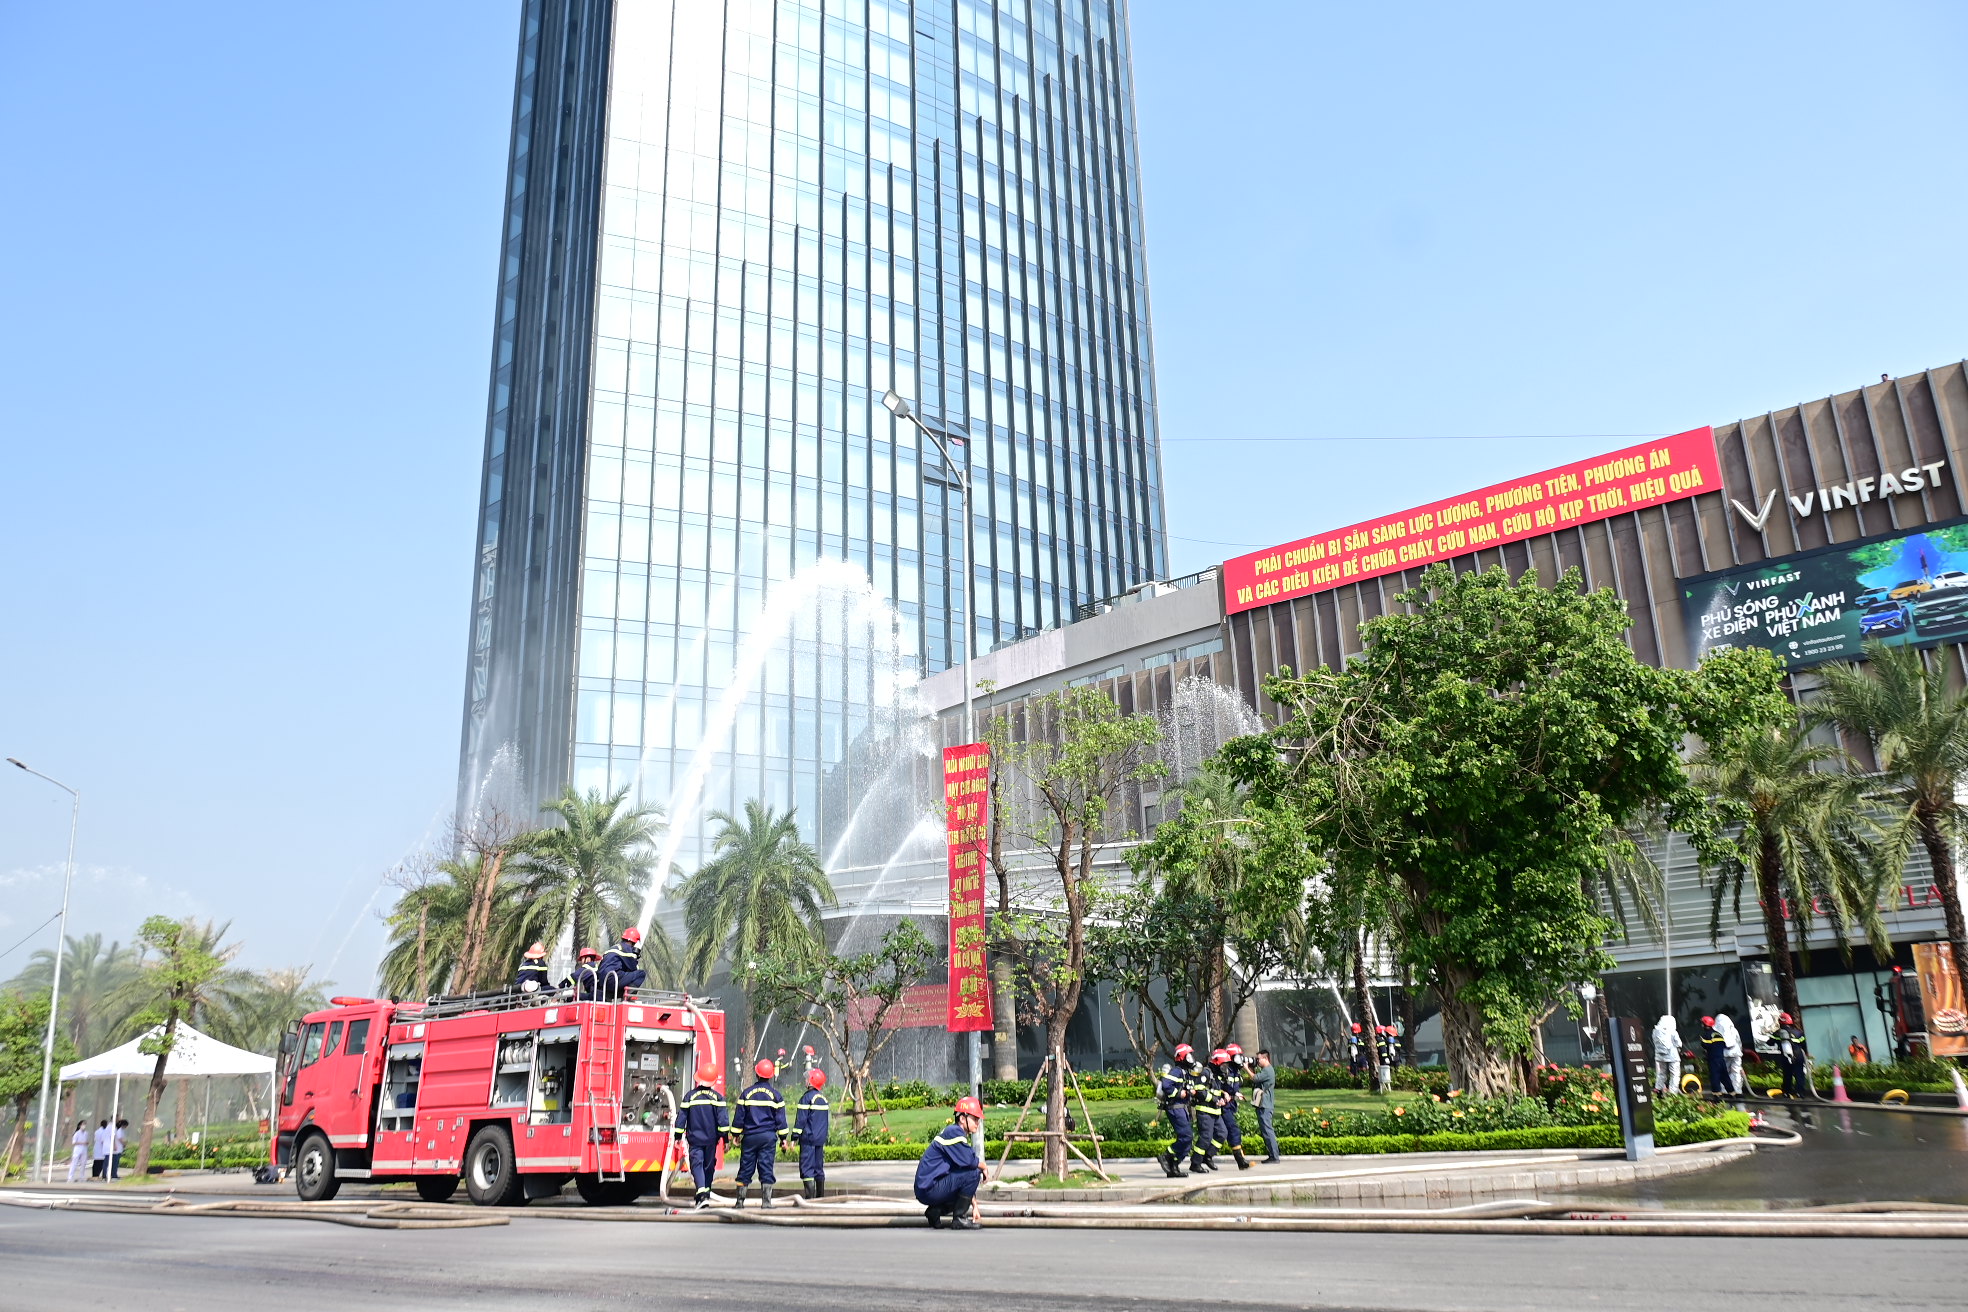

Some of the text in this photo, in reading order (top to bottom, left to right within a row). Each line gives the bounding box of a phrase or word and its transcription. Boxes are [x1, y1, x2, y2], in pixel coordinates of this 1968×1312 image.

[1790, 460, 1945, 518] VINFAST
[1254, 448, 1671, 576] PHẢI CHUẨN BỊ SẴN SÀNG LỰC LƯỢNG, PHƯƠNG TIỆN, PHƯƠNG ÁN
[1237, 464, 1703, 604] VÀ CÁC ĐIỀU KIỆN ĐỂ CHỮA CHÁY, CỨU NẠN, CỨU HỘ KỊP THỜI, HIỆU QUẢ
[1746, 571, 1801, 591] VINFAST
[1700, 596, 1779, 628] PHỦ SÓNG
[1765, 592, 1846, 624] PHỦ XANH
[1766, 608, 1840, 638] VIỆT NAM
[1702, 616, 1758, 641] XE ĐIỆN
